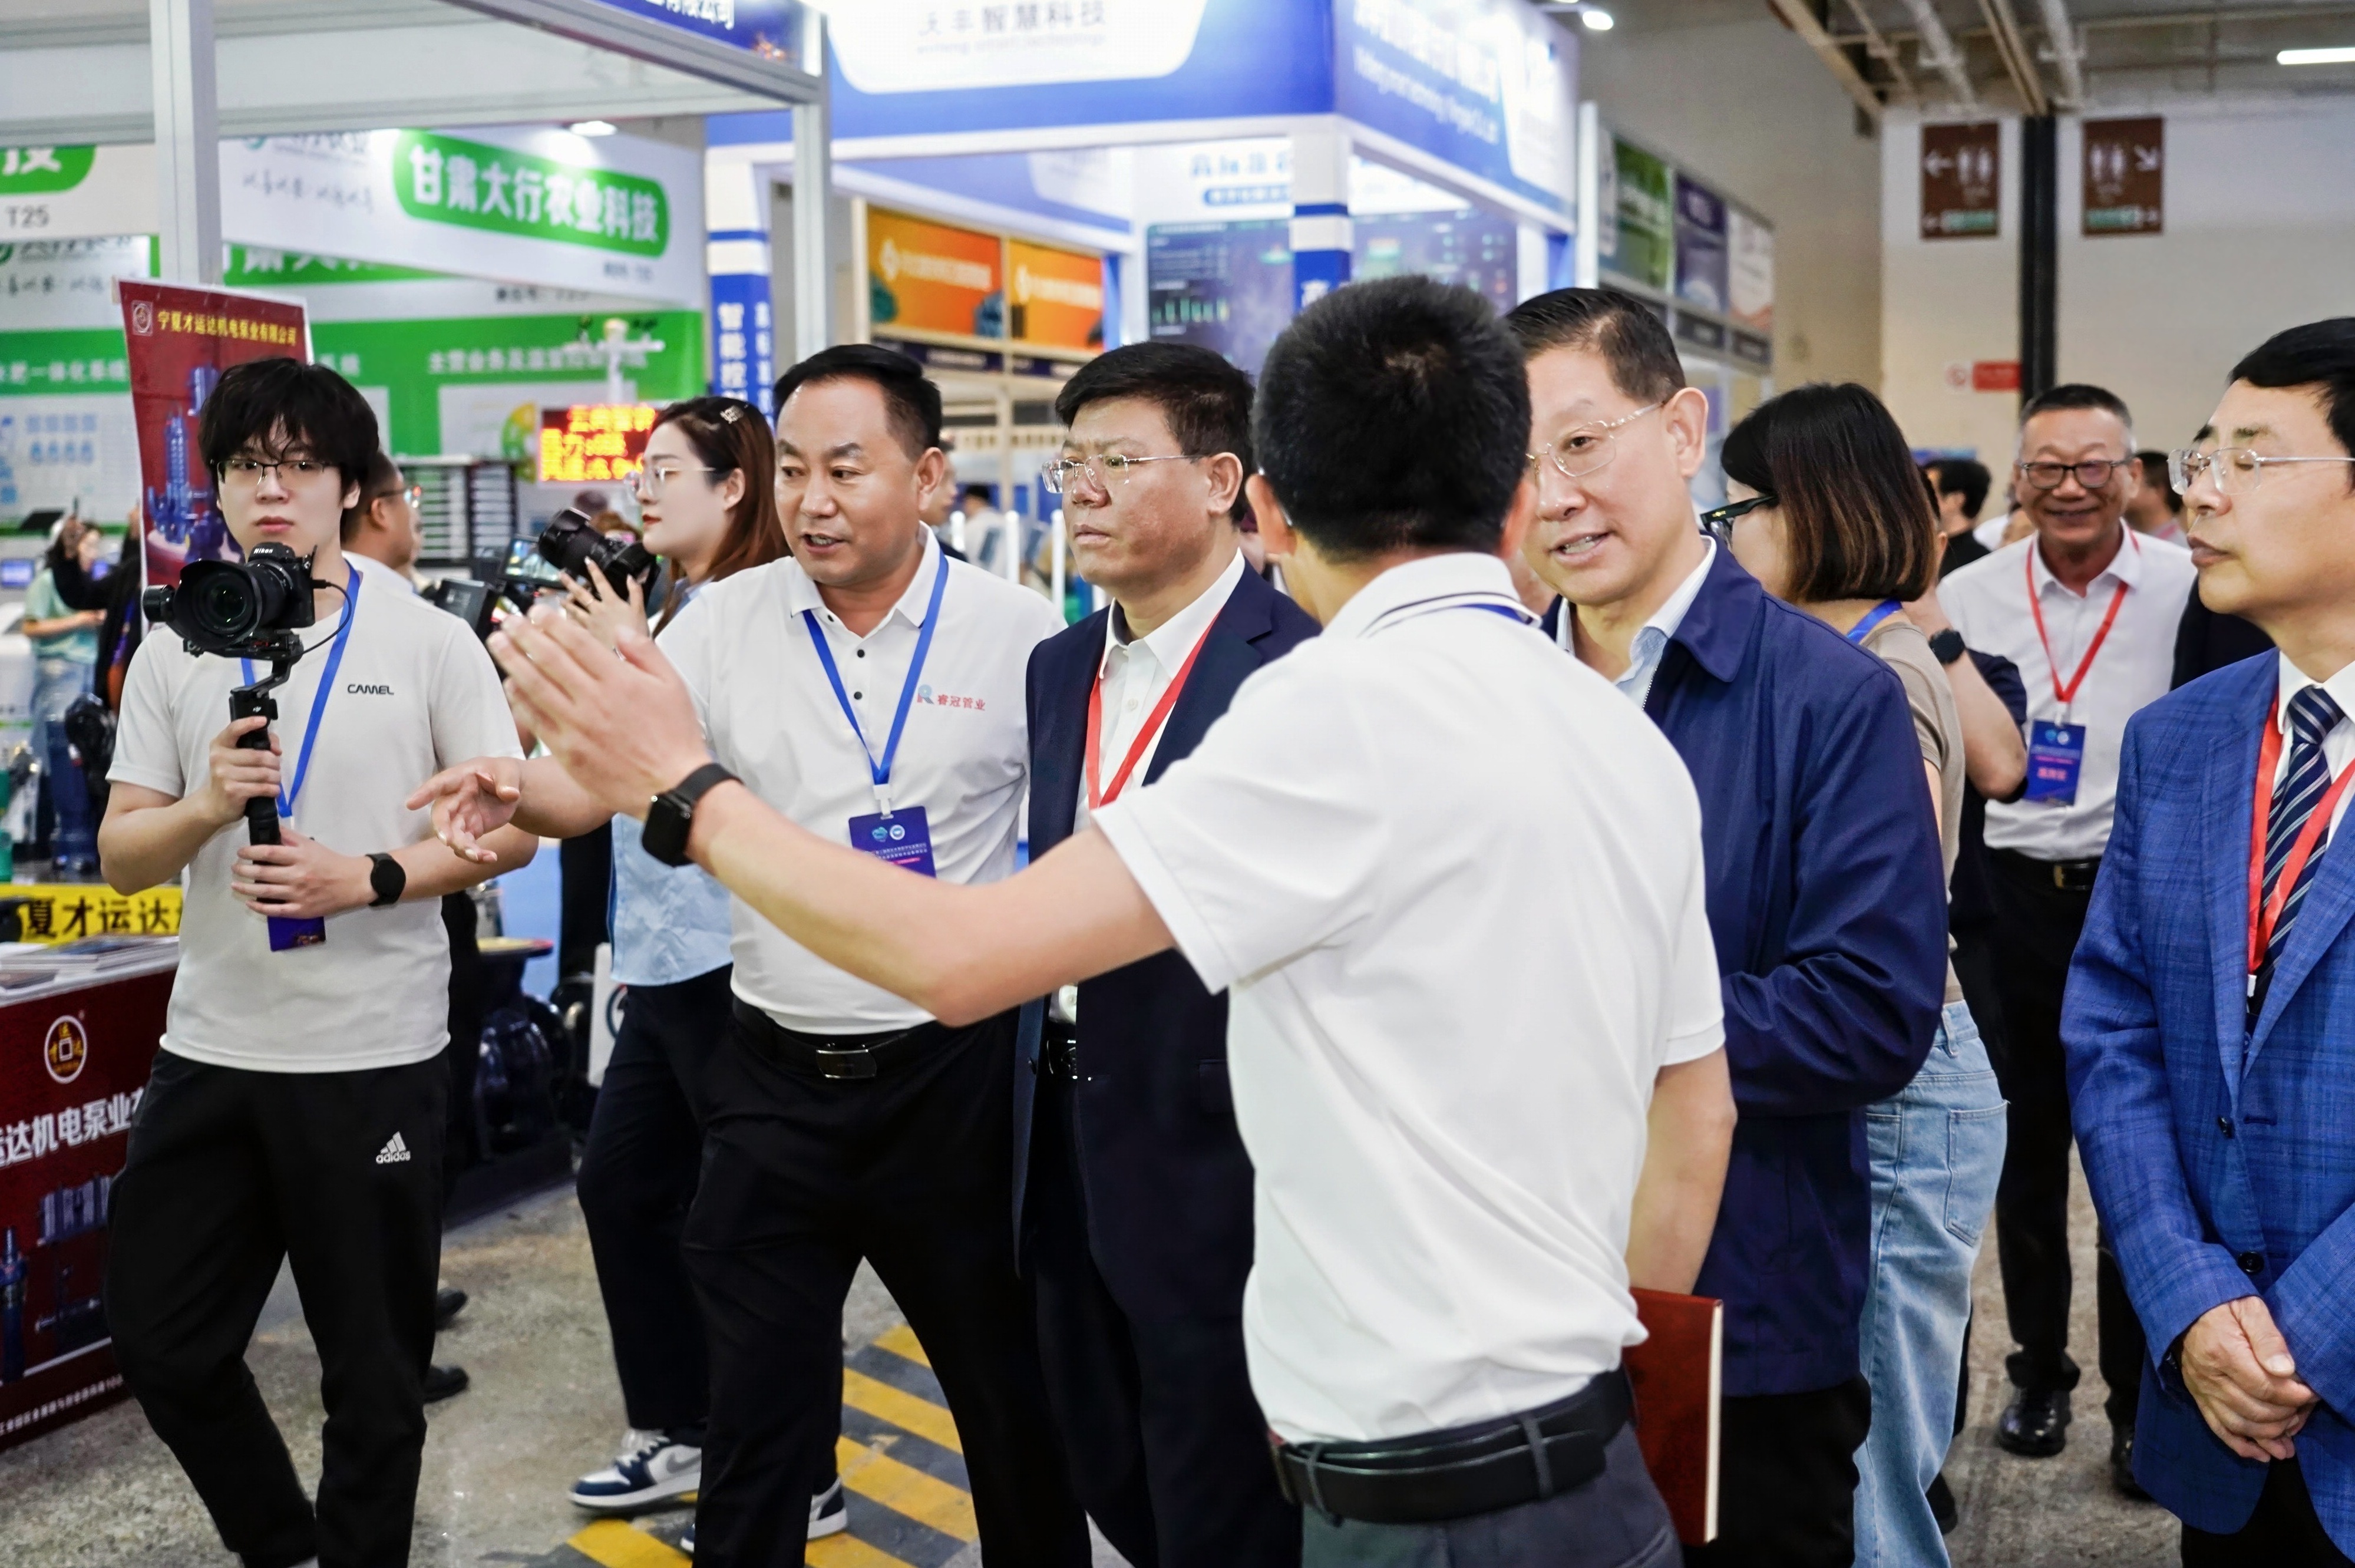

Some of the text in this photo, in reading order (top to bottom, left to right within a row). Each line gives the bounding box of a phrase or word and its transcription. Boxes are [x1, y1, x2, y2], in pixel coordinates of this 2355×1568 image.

[409, 143, 659, 242] 甘肃大行农业科技
[7, 205, 50, 228] T25
[158, 310, 296, 346] 宁夏才运达机电泵业有限公司
[348, 684, 394, 695] CAMEL
[938, 694, 985, 711] 睿冠管业
[27, 895, 183, 938] 夏才运达
[376, 1151, 411, 1164] adidas
